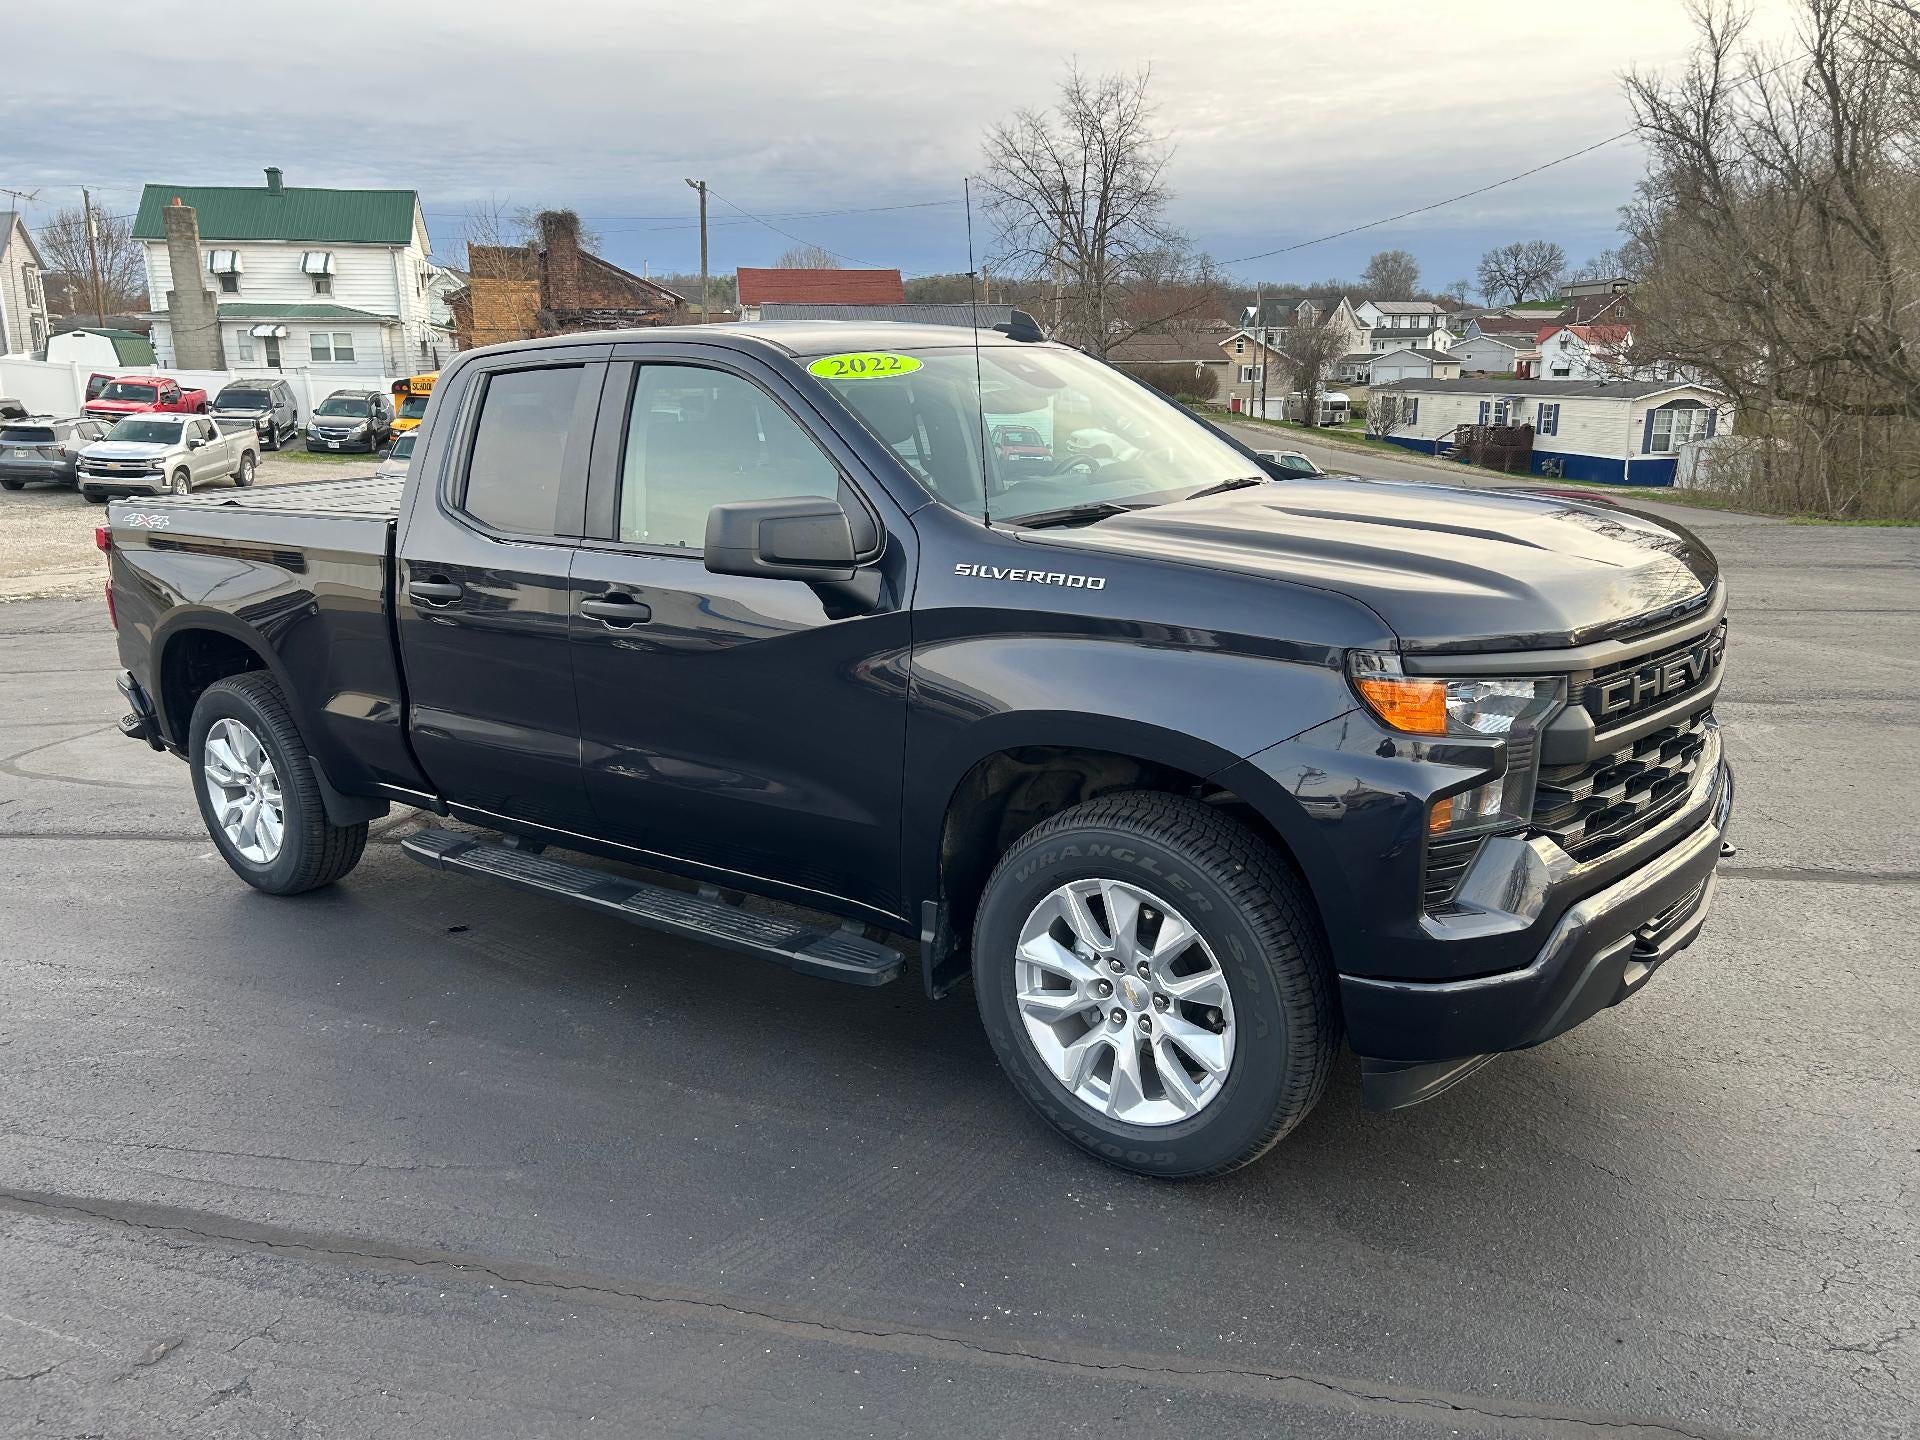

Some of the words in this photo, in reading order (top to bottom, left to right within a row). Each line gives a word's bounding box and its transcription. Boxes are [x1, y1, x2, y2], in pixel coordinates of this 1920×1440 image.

[830, 356, 902, 376] 2022
[954, 563, 1106, 591] SILVERADO
[1015, 843, 1213, 912] WRANGLER
